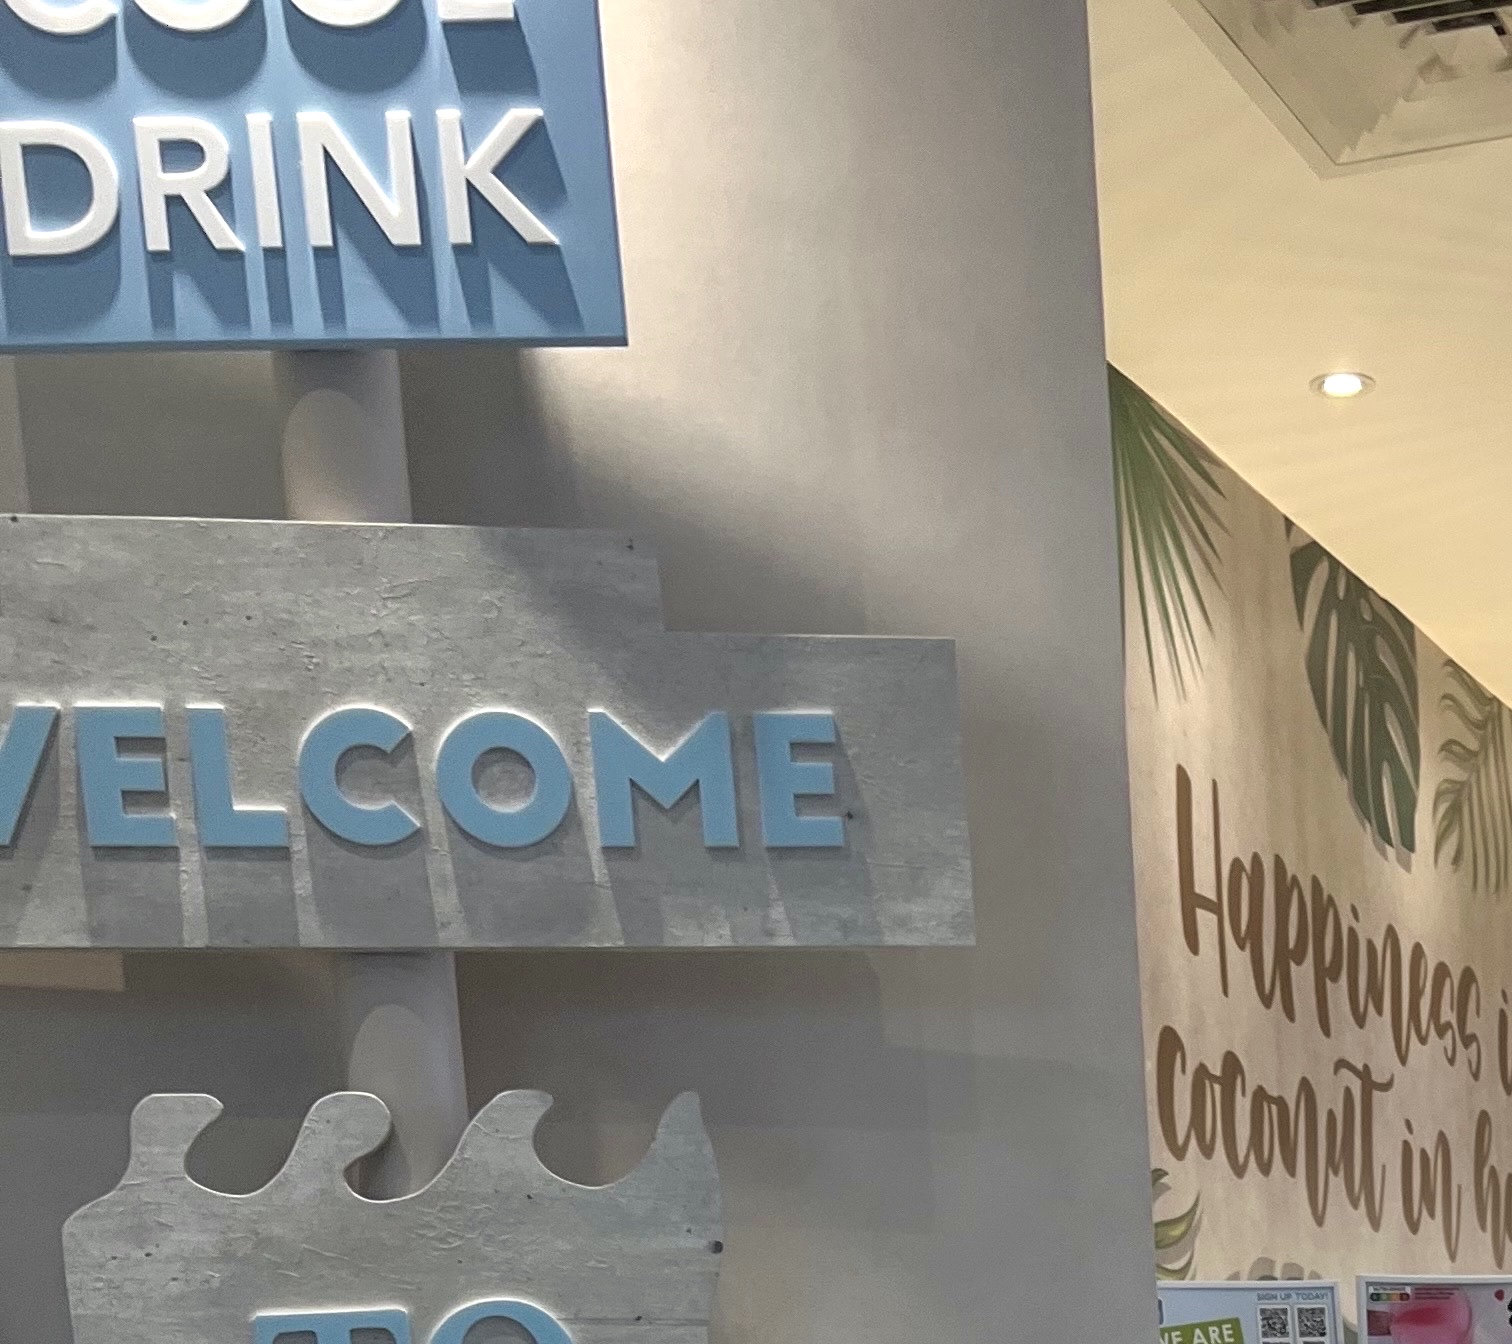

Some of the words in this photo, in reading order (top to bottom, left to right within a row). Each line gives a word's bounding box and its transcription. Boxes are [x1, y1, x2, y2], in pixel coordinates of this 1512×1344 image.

[0, 108, 560, 256] DRINK
[0, 703, 845, 848] ELCOME
[1176, 764, 1481, 1081] Happiness
[1402, 1118, 1462, 1263] in
